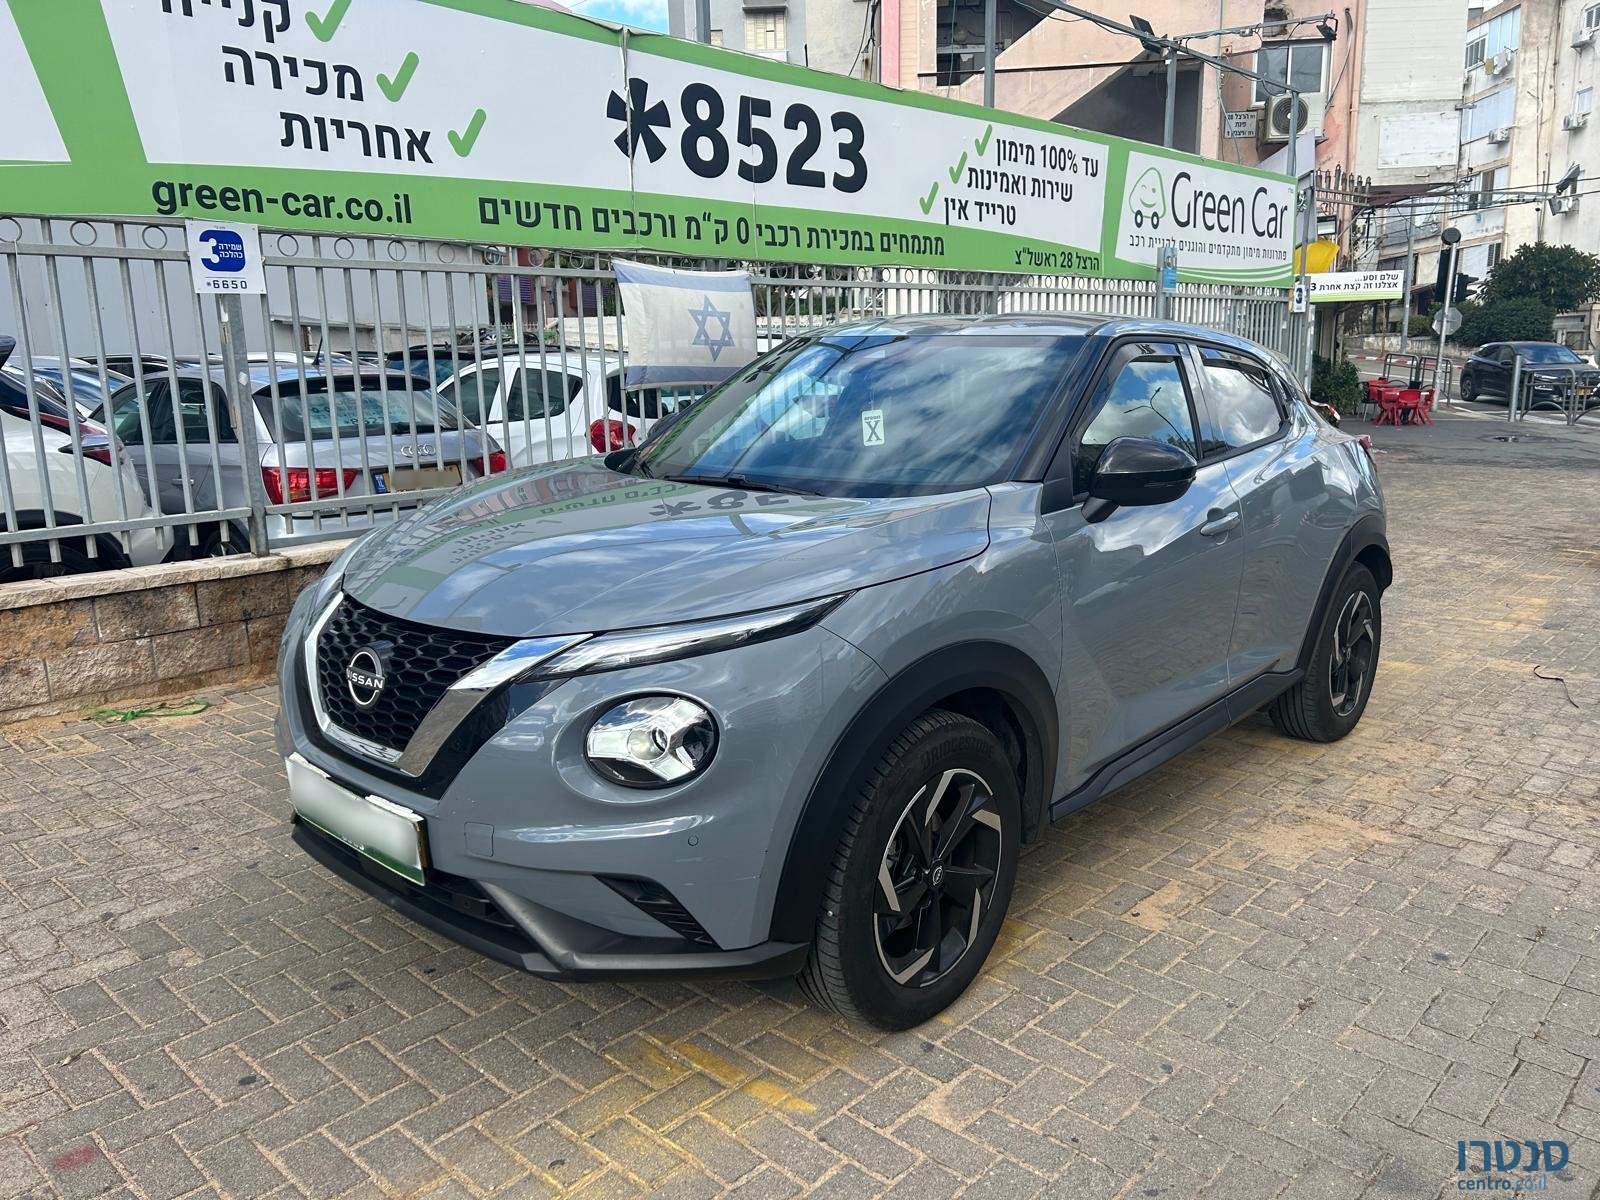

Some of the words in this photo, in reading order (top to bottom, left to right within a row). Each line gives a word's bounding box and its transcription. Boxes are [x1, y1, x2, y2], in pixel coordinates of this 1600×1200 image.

[221, 45, 365, 102] מכירה
[279, 111, 434, 164] אחריות
[996, 138, 1035, 167] מימון
[1040, 144, 1078, 174] 100%
[1081, 156, 1099, 178] עד
[967, 166, 1026, 196] ואמינות
[1031, 177, 1073, 203] שירות
[151, 179, 412, 224] green-car.co.il
[478, 197, 582, 231] חדשים
[944, 197, 969, 226] אין
[974, 201, 1017, 226] טרייד
[1170, 171, 1245, 235] Green
[1251, 186, 1288, 240] Car
[591, 207, 677, 239] ורכבים
[756, 223, 801, 248] רכבי
[218, 243, 242, 251] שמירה
[807, 227, 875, 251] במכירת
[880, 232, 945, 256] מתמחים
[1129, 234, 1145, 247] רכב
[1060, 251, 1073, 269] 28
[1075, 251, 1100, 271] הרצל
[1344, 282, 1361, 291] קצת
[1374, 281, 1398, 289] אצלנו
[1380, 273, 1399, 281] שלם
